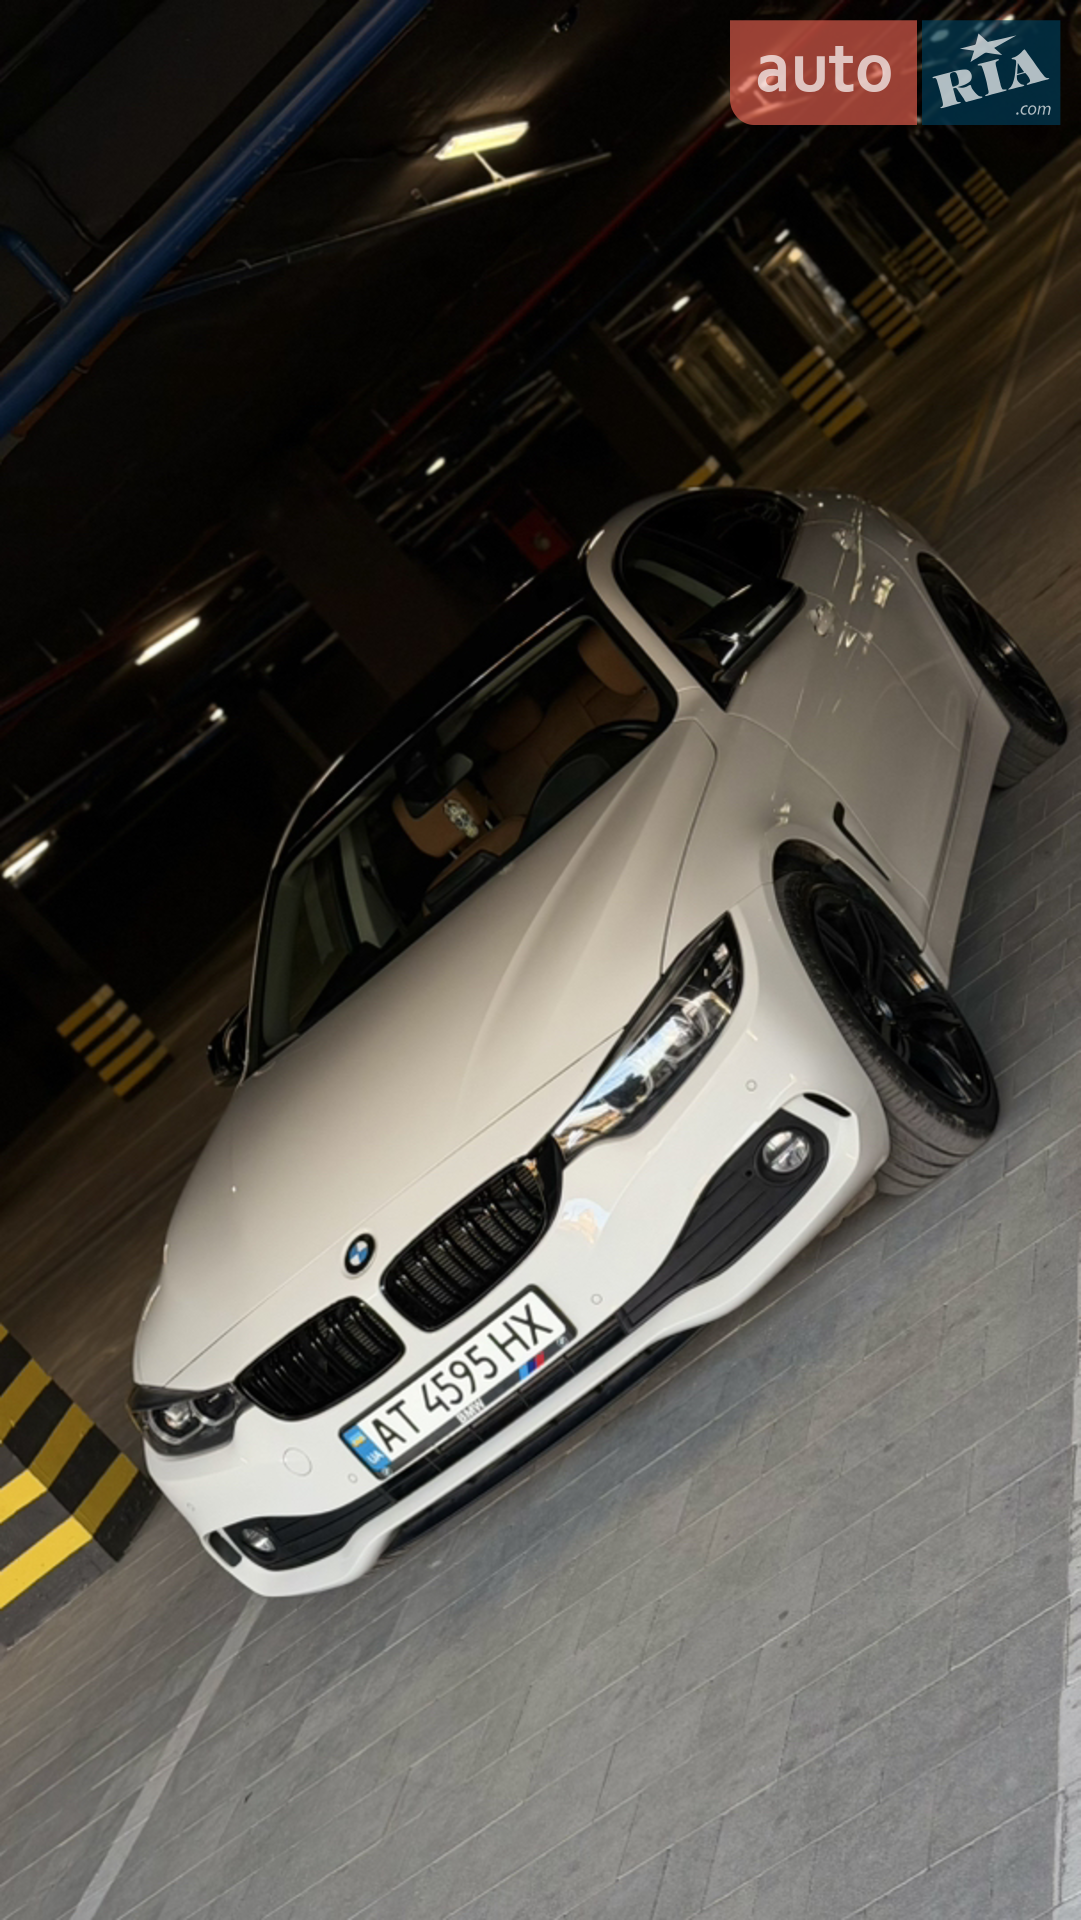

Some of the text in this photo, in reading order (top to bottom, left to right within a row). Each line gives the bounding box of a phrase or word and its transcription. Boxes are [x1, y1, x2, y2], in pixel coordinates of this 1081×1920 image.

[371, 1303, 553, 1452] AT 4595 HX
[457, 1397, 486, 1424] BMW
[366, 1450, 385, 1465] UA
